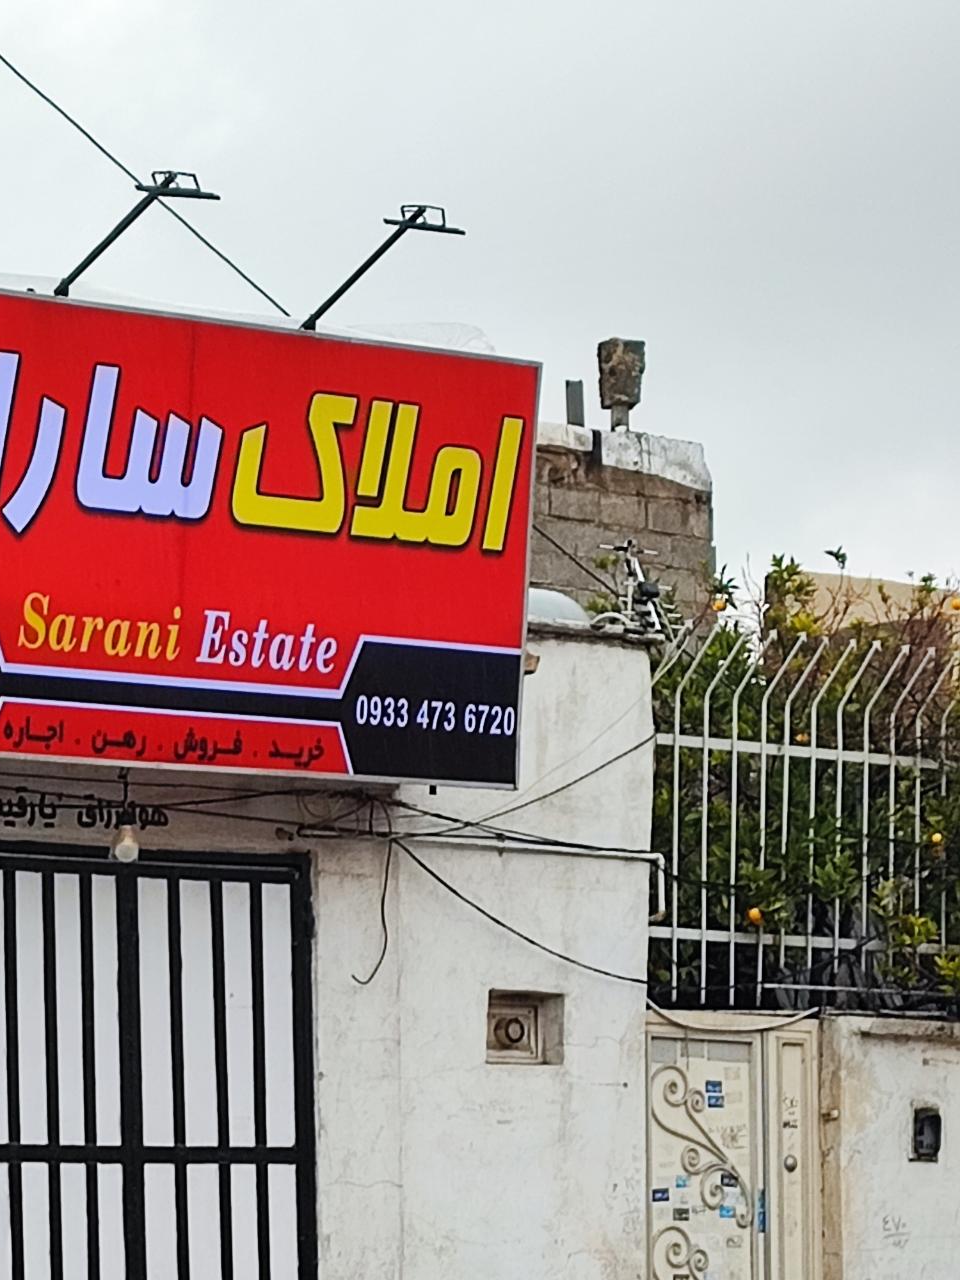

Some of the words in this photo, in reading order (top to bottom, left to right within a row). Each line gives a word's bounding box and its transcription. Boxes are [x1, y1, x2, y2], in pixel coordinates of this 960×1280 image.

[231, 393, 525, 552] املاک
[17, 592, 181, 662] Sarani
[196, 609, 338, 674] Estate
[3, 716, 65, 749] اجاره
[356, 695, 409, 728] 0933
[416, 700, 456, 732] 473
[464, 704, 516, 736] 6720
[91, 729, 147, 757] رهن
[174, 727, 244, 762] فروش
[269, 736, 325, 767] خرید
[77, 793, 170, 831] هورزاق
